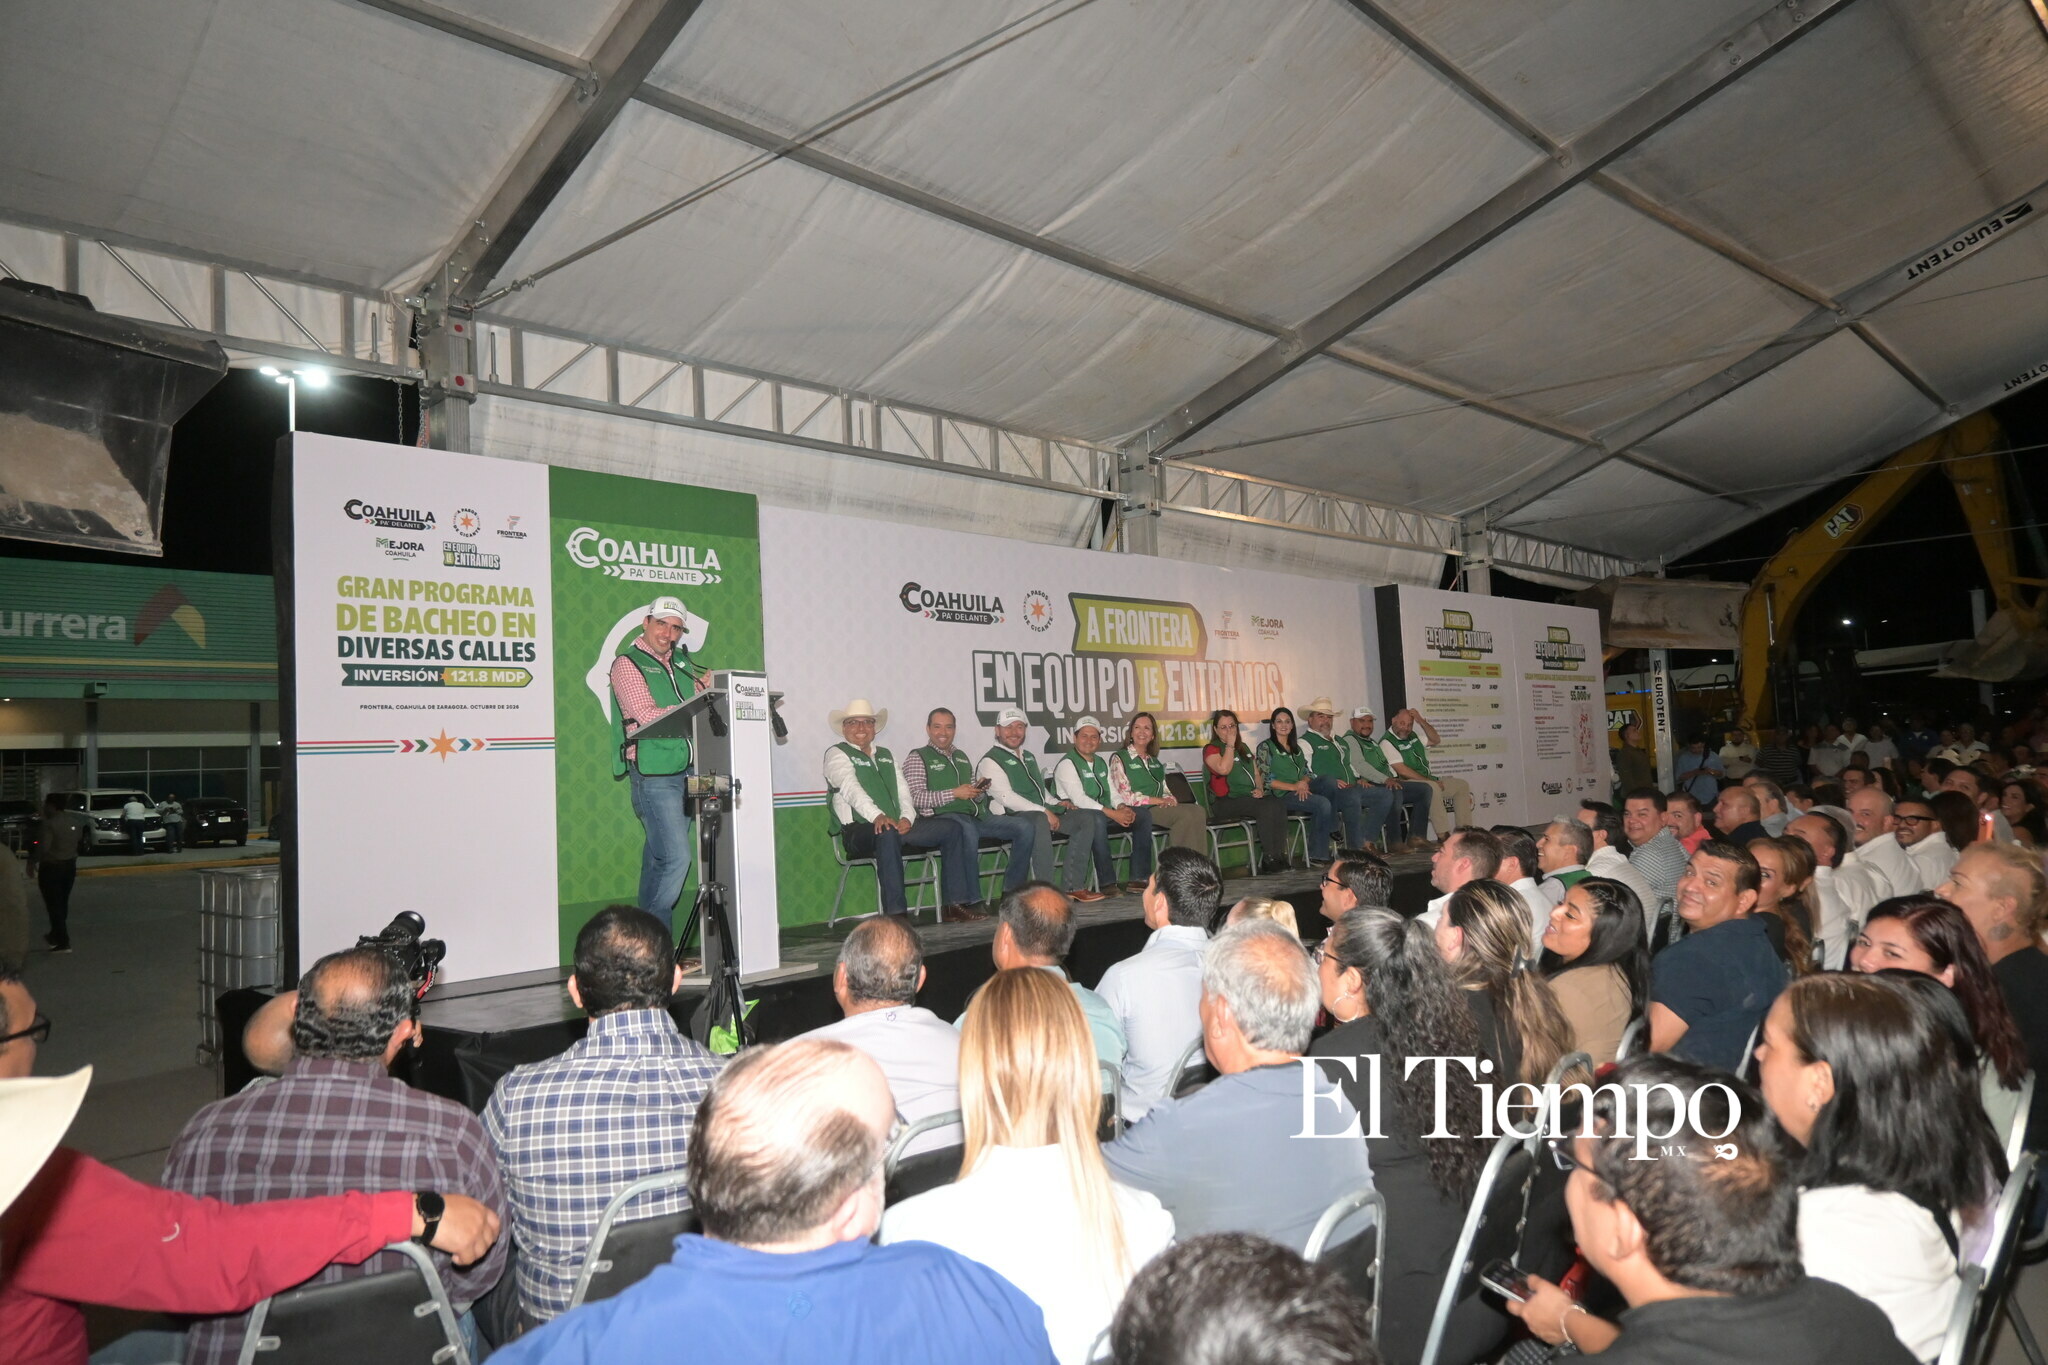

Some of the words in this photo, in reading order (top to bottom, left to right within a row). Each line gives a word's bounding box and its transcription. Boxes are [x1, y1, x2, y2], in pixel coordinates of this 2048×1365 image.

[1908, 218, 2004, 280] EUROTENT
[343, 499, 436, 523] COAHUILA
[1824, 507, 1854, 537] CAT
[391, 521, 421, 529] DELANTE
[376, 537, 425, 551] MEJORA
[385, 550, 416, 558] COAHUILA
[452, 543, 476, 553] EQUIPO
[565, 526, 721, 571] COAHUILA
[454, 552, 499, 568] ENTRAMOS
[629, 568, 646, 578] PA'
[649, 569, 697, 582] DELANTE
[337, 575, 404, 600] GRAN
[409, 580, 534, 607] PROGRAMA
[899, 581, 1004, 613] COAHUILA
[336, 603, 377, 632] DE
[383, 605, 496, 637] BACHEO
[502, 611, 536, 638] EN
[955, 613, 988, 623] DELANTE
[1087, 606, 1100, 643] A
[1104, 608, 1193, 649] FRONTERA
[337, 635, 454, 660] DIVERSAS
[459, 640, 536, 662] CALLES
[354, 668, 438, 682] INVERSIÓN
[451, 670, 488, 682] 121.8
[492, 671, 525, 683] MDP
[973, 652, 1017, 712] EN
[1022, 655, 1136, 718] EQUIPO
[1144, 667, 1159, 705] LE
[1164, 660, 1282, 712] ENTRAMOS
[1655, 676, 1665, 732] EUROTENT
[1607, 710, 1631, 729] CAT
[1056, 722, 1130, 745] INRSIÓ
[1159, 723, 1196, 742] 121.8
